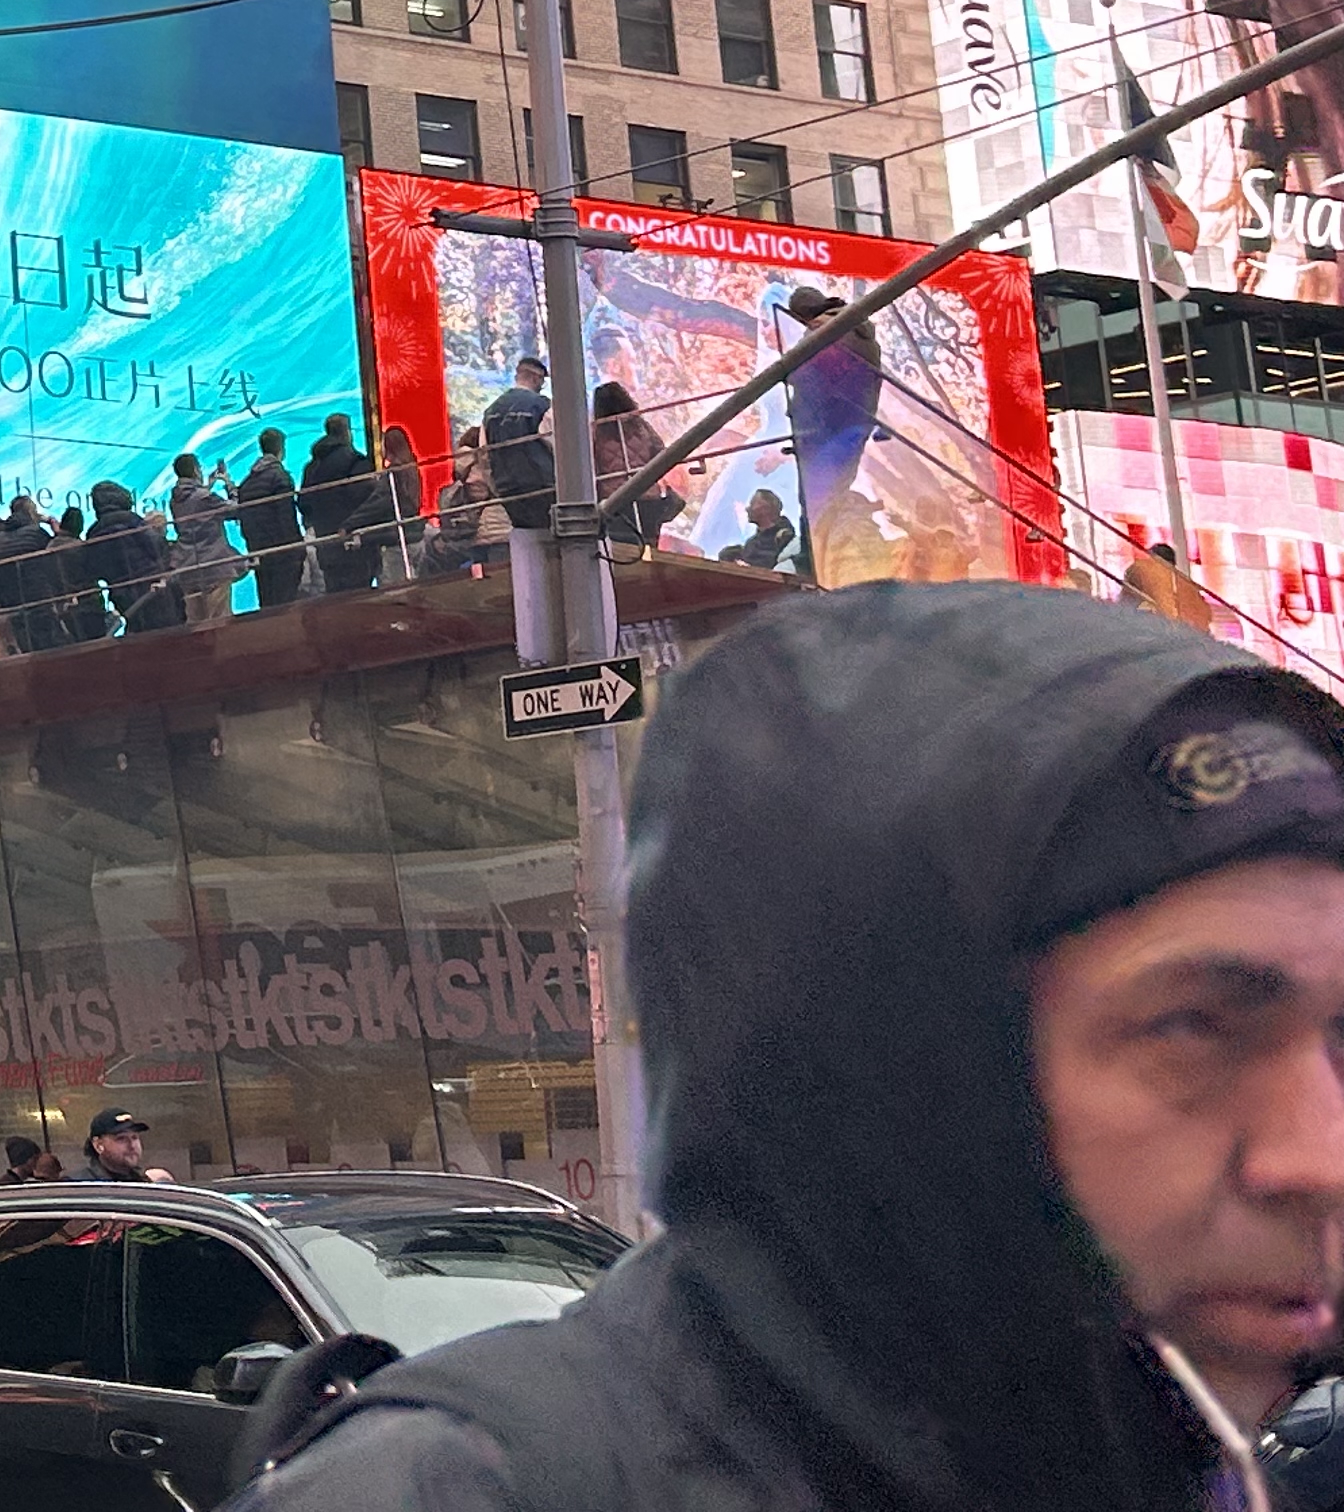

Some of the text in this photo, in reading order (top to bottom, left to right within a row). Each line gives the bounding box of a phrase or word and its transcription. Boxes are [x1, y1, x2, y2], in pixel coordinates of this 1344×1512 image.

[588, 211, 831, 265] CONGRATULATIONS
[523, 679, 621, 716] ONE WAY
[558, 1158, 595, 1201] 10
